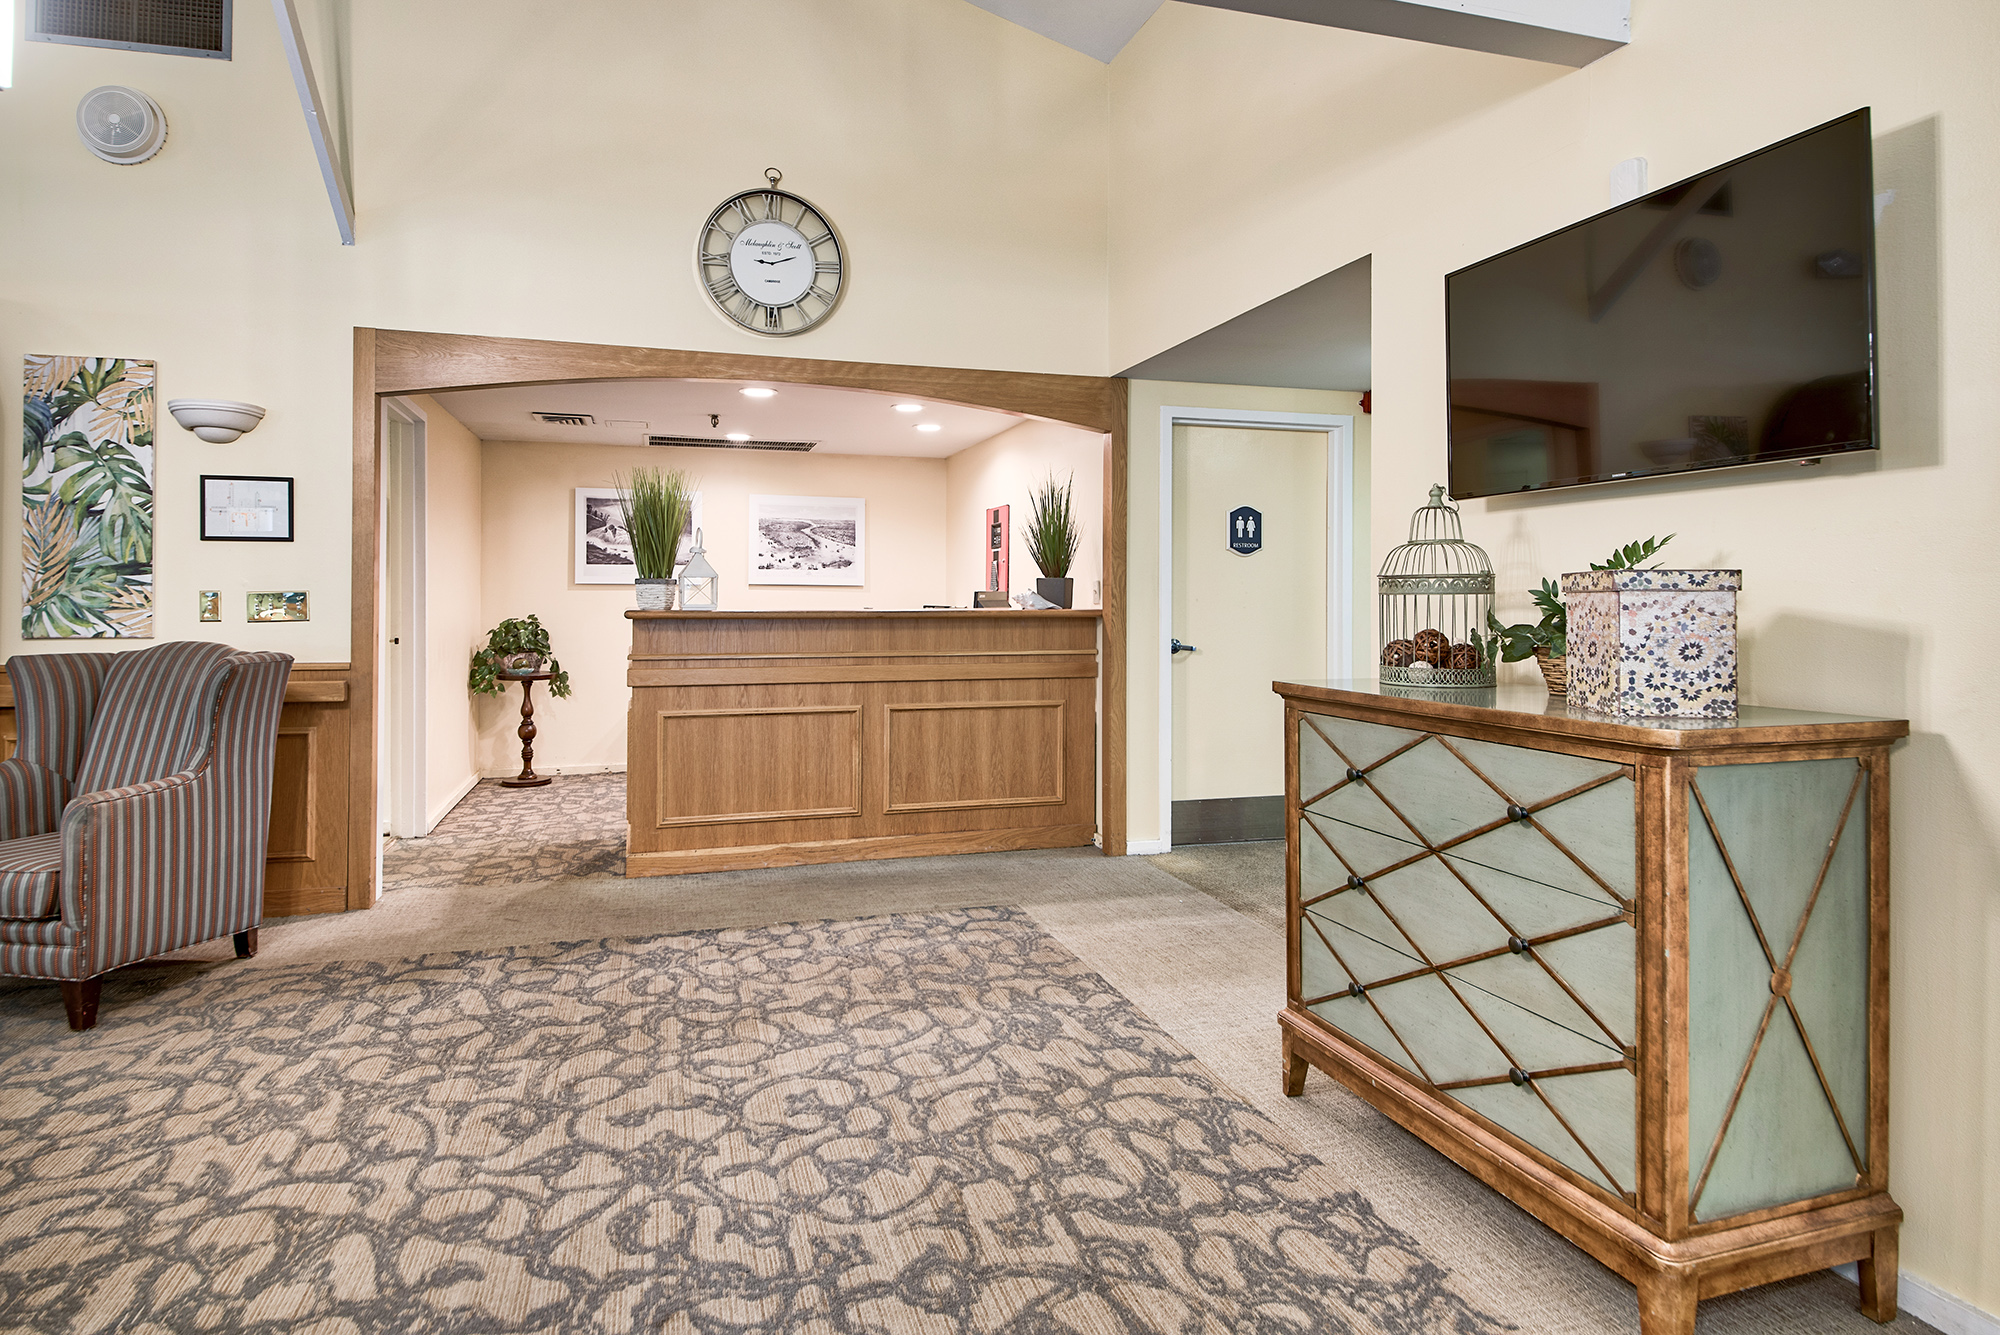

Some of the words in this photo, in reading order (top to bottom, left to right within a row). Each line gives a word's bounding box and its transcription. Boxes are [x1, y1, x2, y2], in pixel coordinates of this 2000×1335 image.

[762, 194, 780, 220] XII
[777, 242, 784, 251] &
[785, 241, 802, 250] Scott
